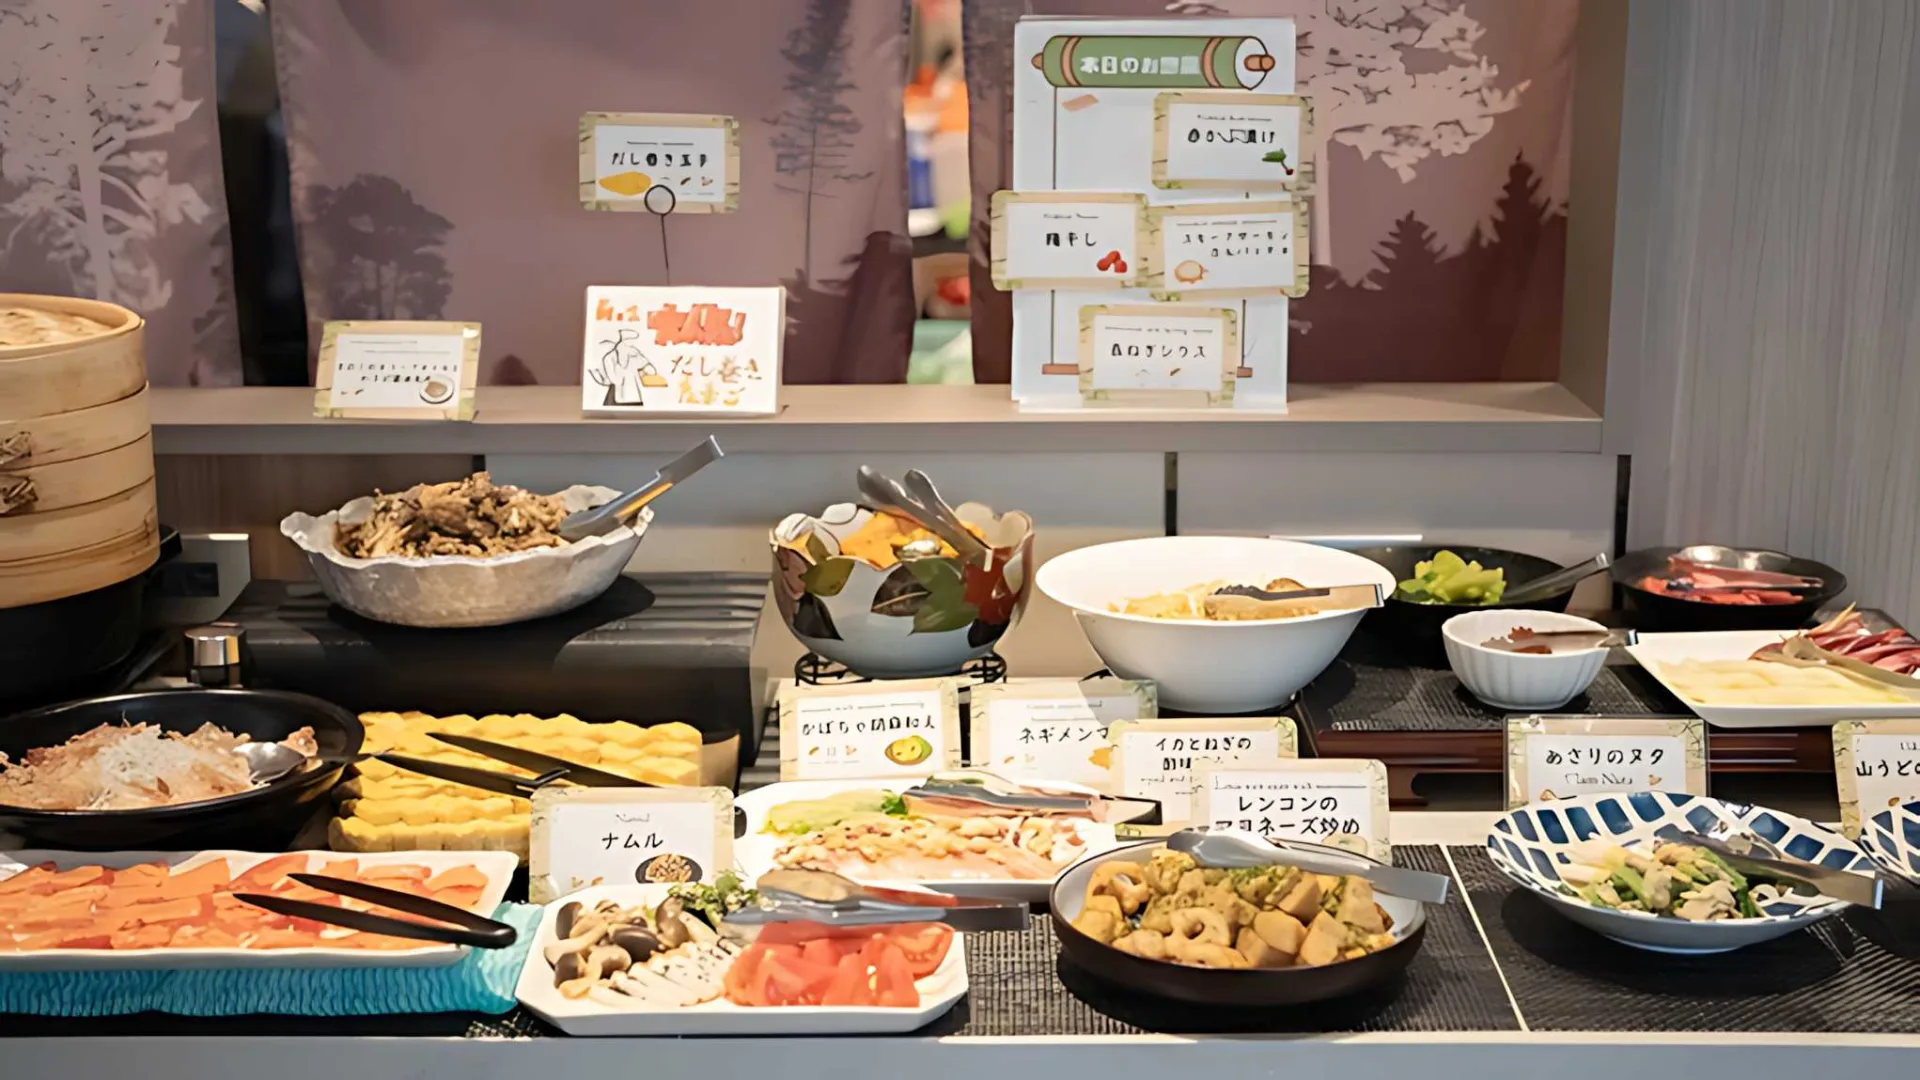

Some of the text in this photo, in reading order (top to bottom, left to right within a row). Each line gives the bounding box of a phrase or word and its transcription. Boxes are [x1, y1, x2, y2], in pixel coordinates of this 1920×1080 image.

[1046, 232, 1097, 247] 干し
[1156, 736, 1251, 751] イカとねぎの
[1546, 748, 1664, 765] あさりのヌタ
[1239, 796, 1338, 812] レンコンの
[602, 832, 663, 850] ナムル
